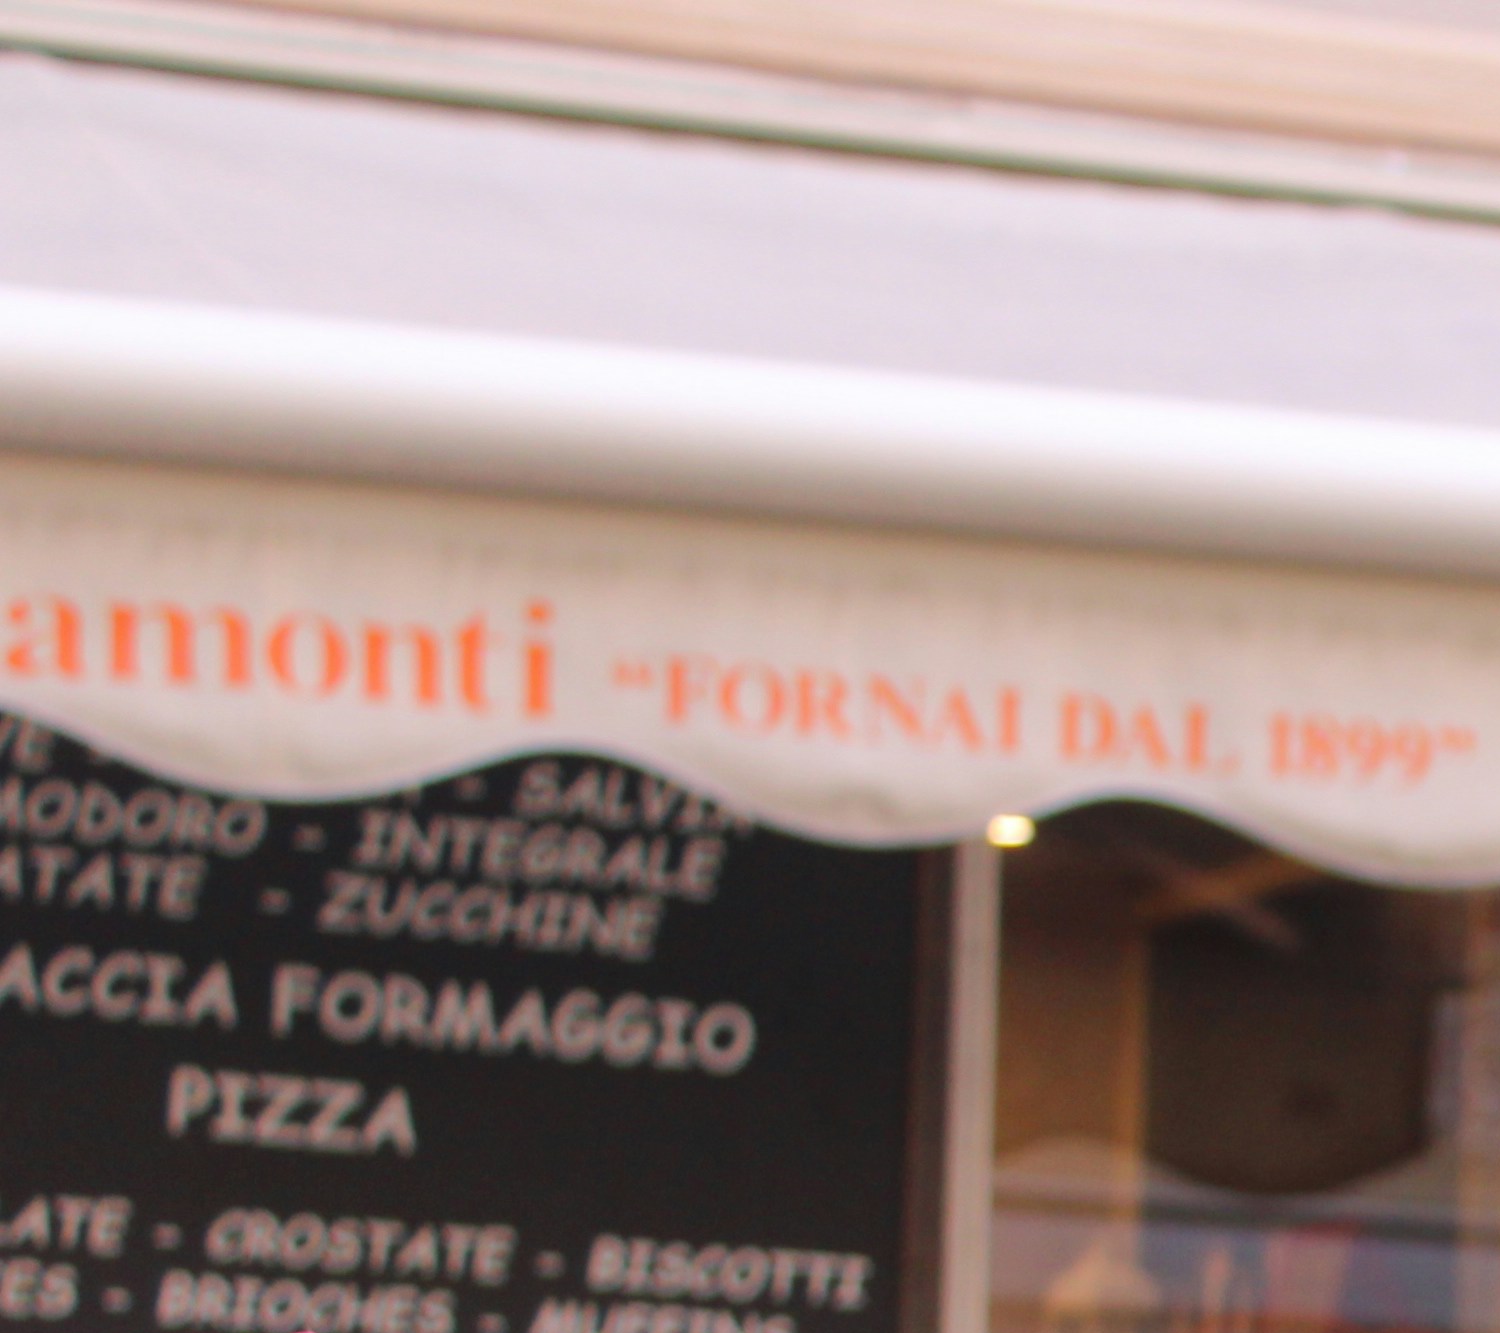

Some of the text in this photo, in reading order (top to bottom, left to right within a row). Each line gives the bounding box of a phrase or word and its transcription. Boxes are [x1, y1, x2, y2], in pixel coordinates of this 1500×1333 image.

[3, 594, 557, 722] amonti
[1057, 690, 1240, 776] DAL
[352, 806, 726, 902] INTEGRALE
[320, 868, 665, 960] ZUCCHINE
[271, 962, 758, 1077] FORMAGGIO
[166, 1063, 417, 1157] PIZZA
[205, 1206, 518, 1287] CROSTATE
[586, 1233, 872, 1312] BISCOTTI
